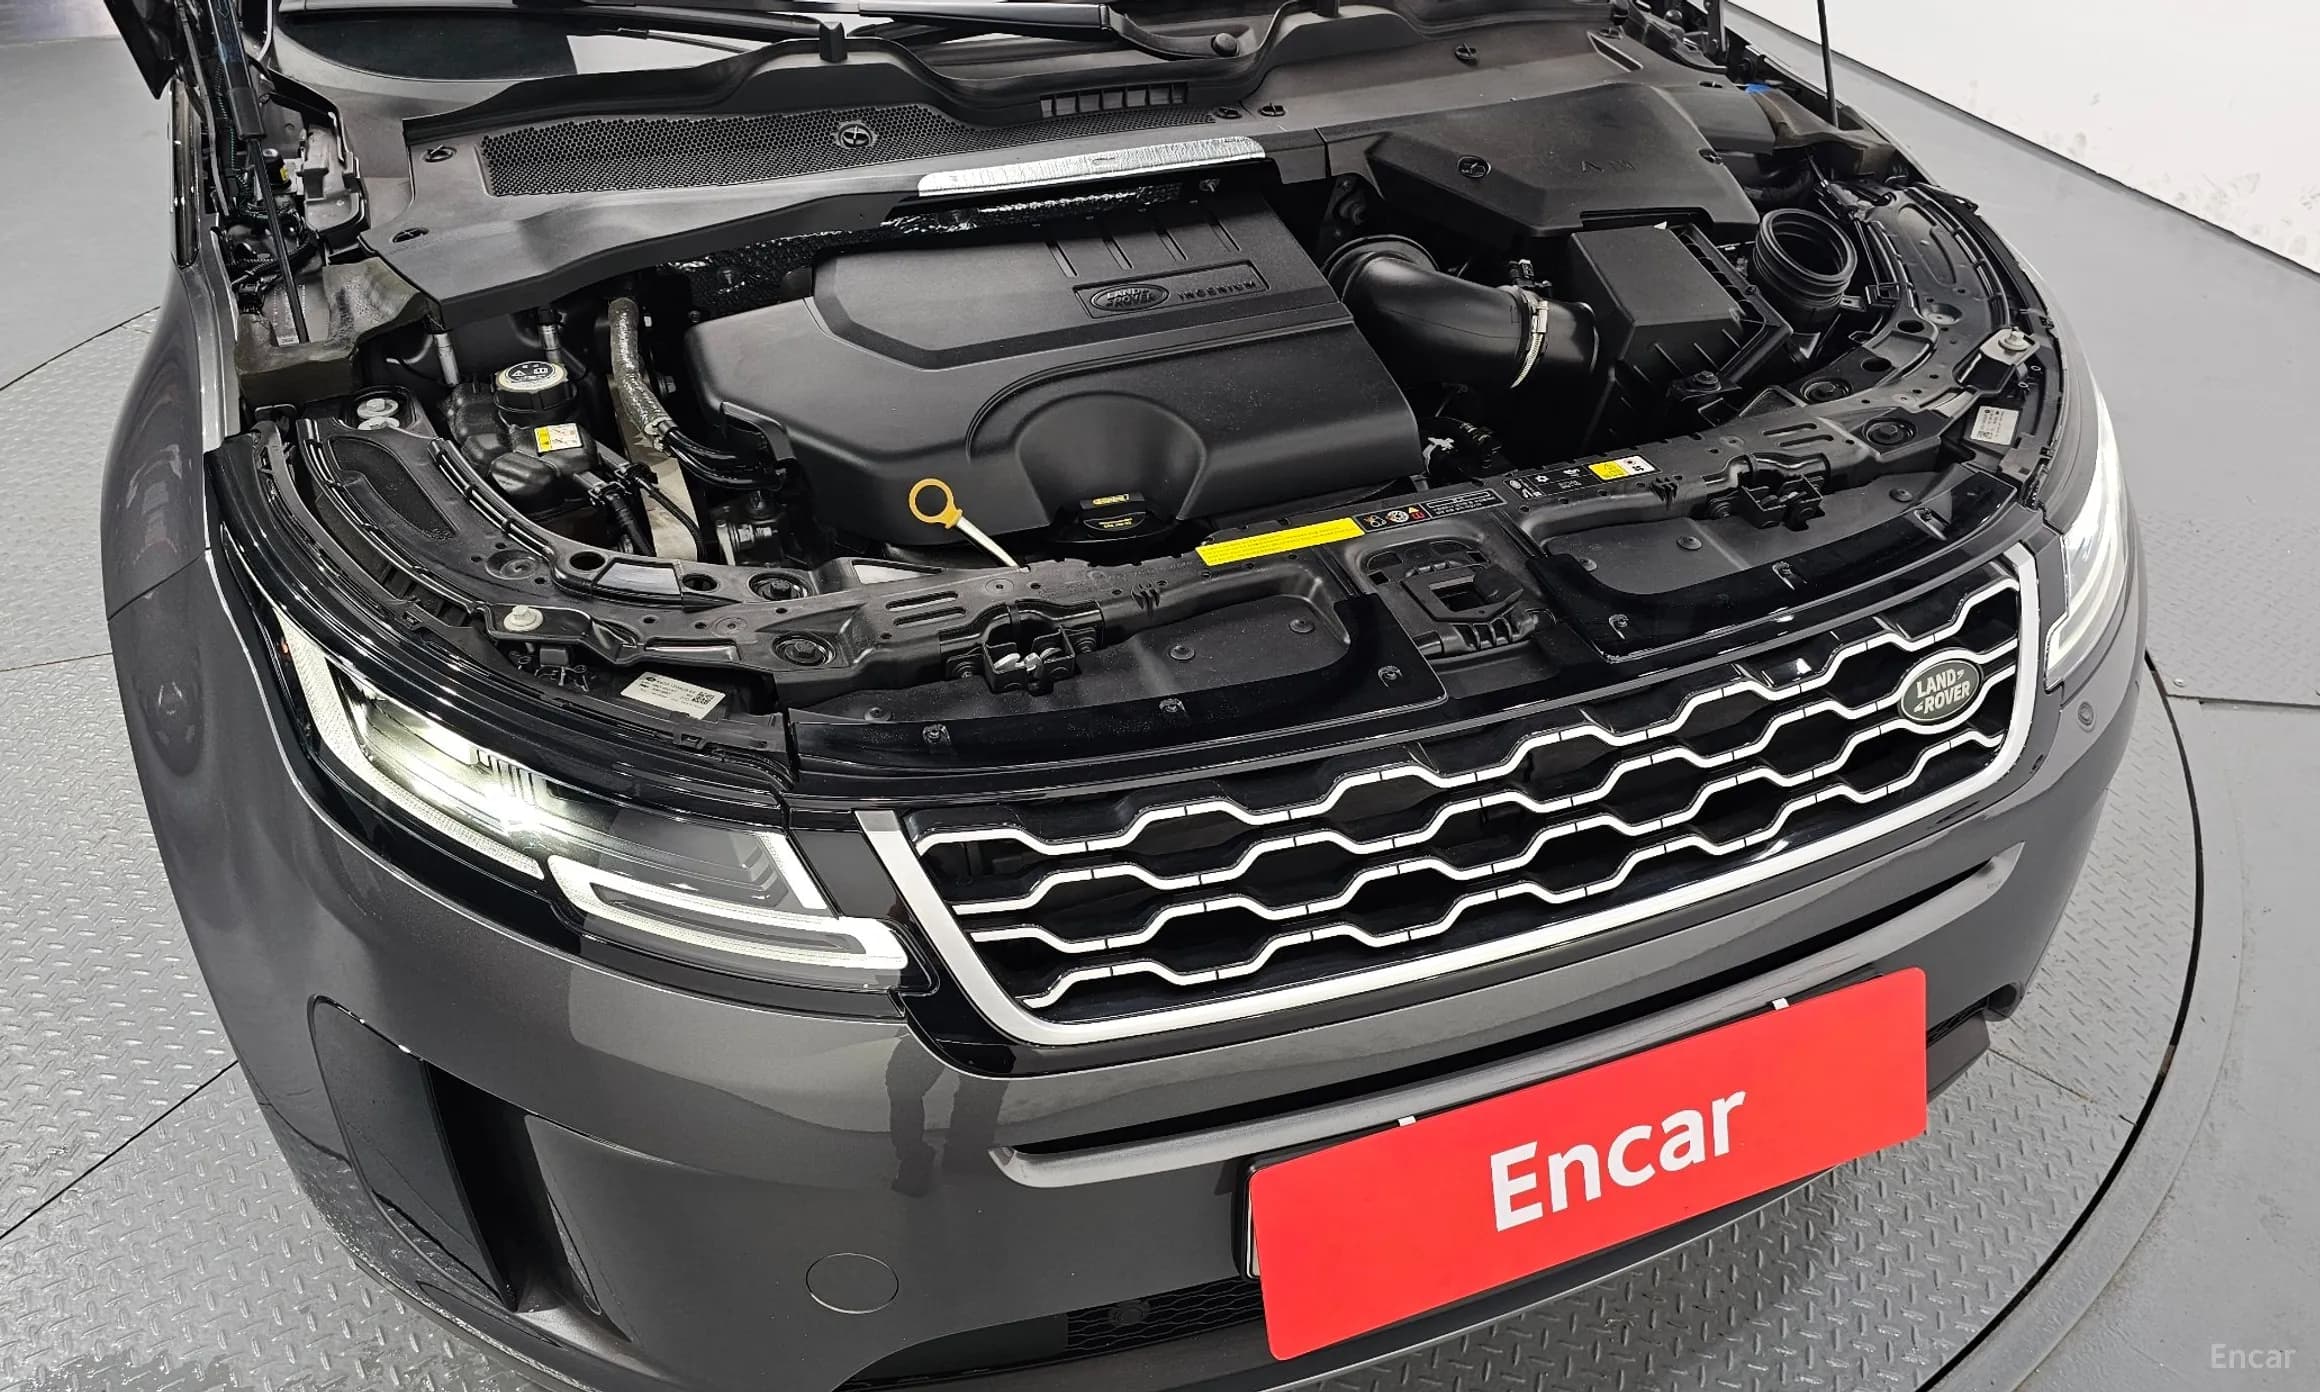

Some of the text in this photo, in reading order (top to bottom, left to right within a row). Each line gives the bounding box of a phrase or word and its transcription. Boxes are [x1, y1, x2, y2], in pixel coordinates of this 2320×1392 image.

[1916, 668, 1957, 699] LAND
[1923, 680, 1970, 714] ROVER
[1490, 1091, 1746, 1232] Encar
